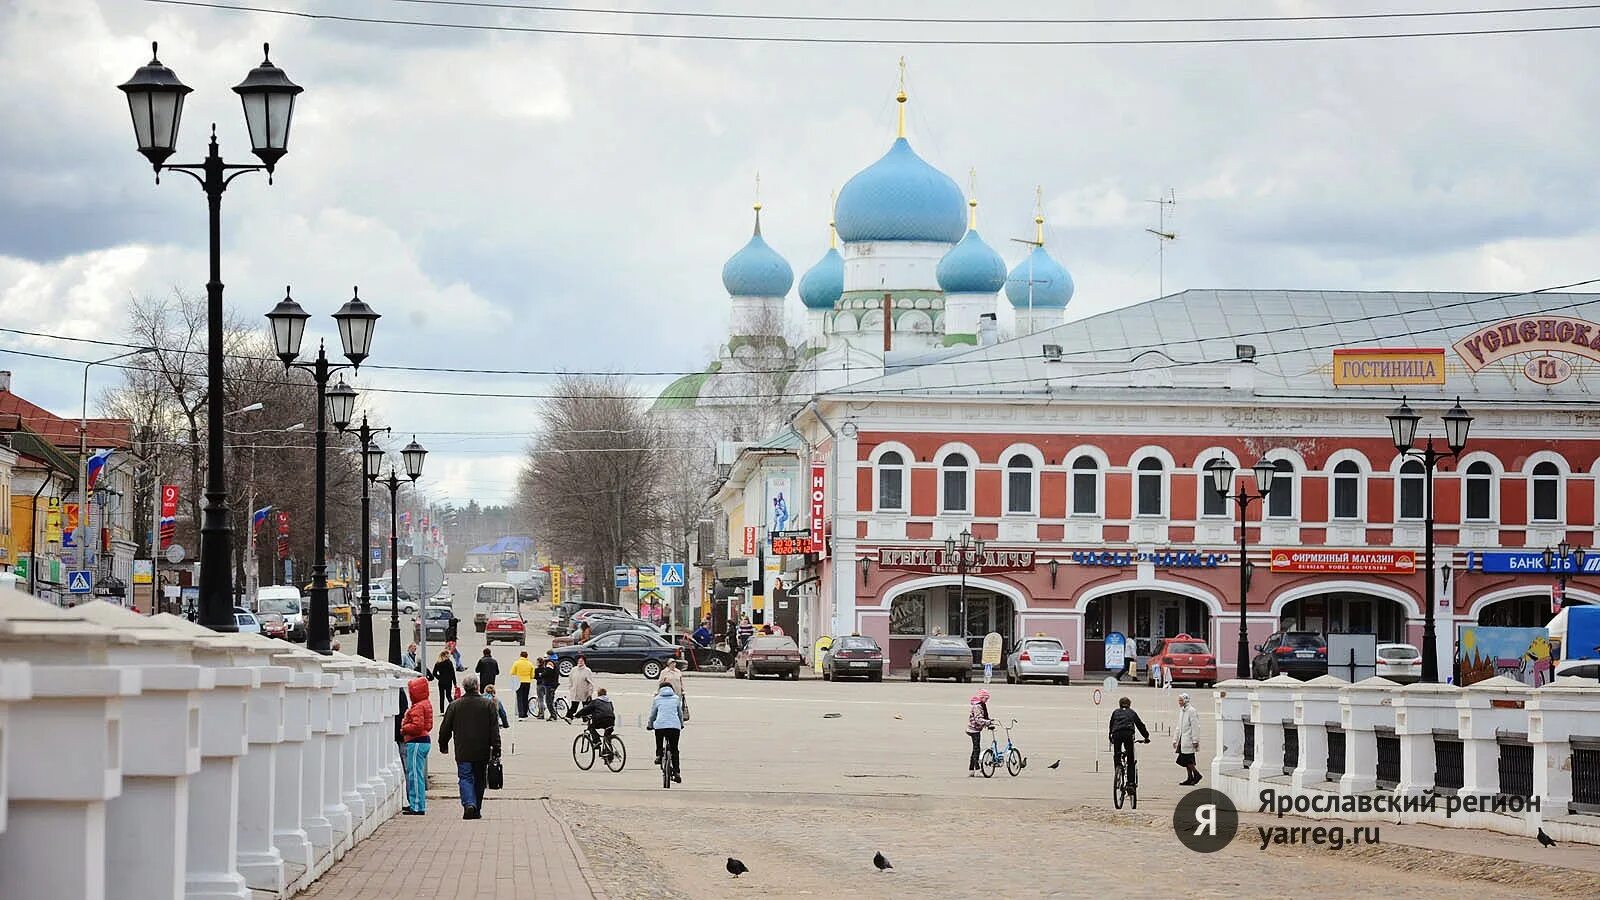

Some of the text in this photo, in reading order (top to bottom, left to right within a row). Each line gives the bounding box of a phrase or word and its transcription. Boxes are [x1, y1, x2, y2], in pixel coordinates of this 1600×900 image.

[1343, 359, 1437, 381] ГОСТИНИЦА
[1538, 360, 1557, 379] ГД
[165, 488, 175, 501] 9
[813, 476, 824, 544] HOTEL
[1072, 551, 1130, 566] ЧАСЫ
[1292, 553, 1394, 563] ФИРМЕННЫЙ МАГАЗИН
[1509, 557, 1544, 569] БАНК
